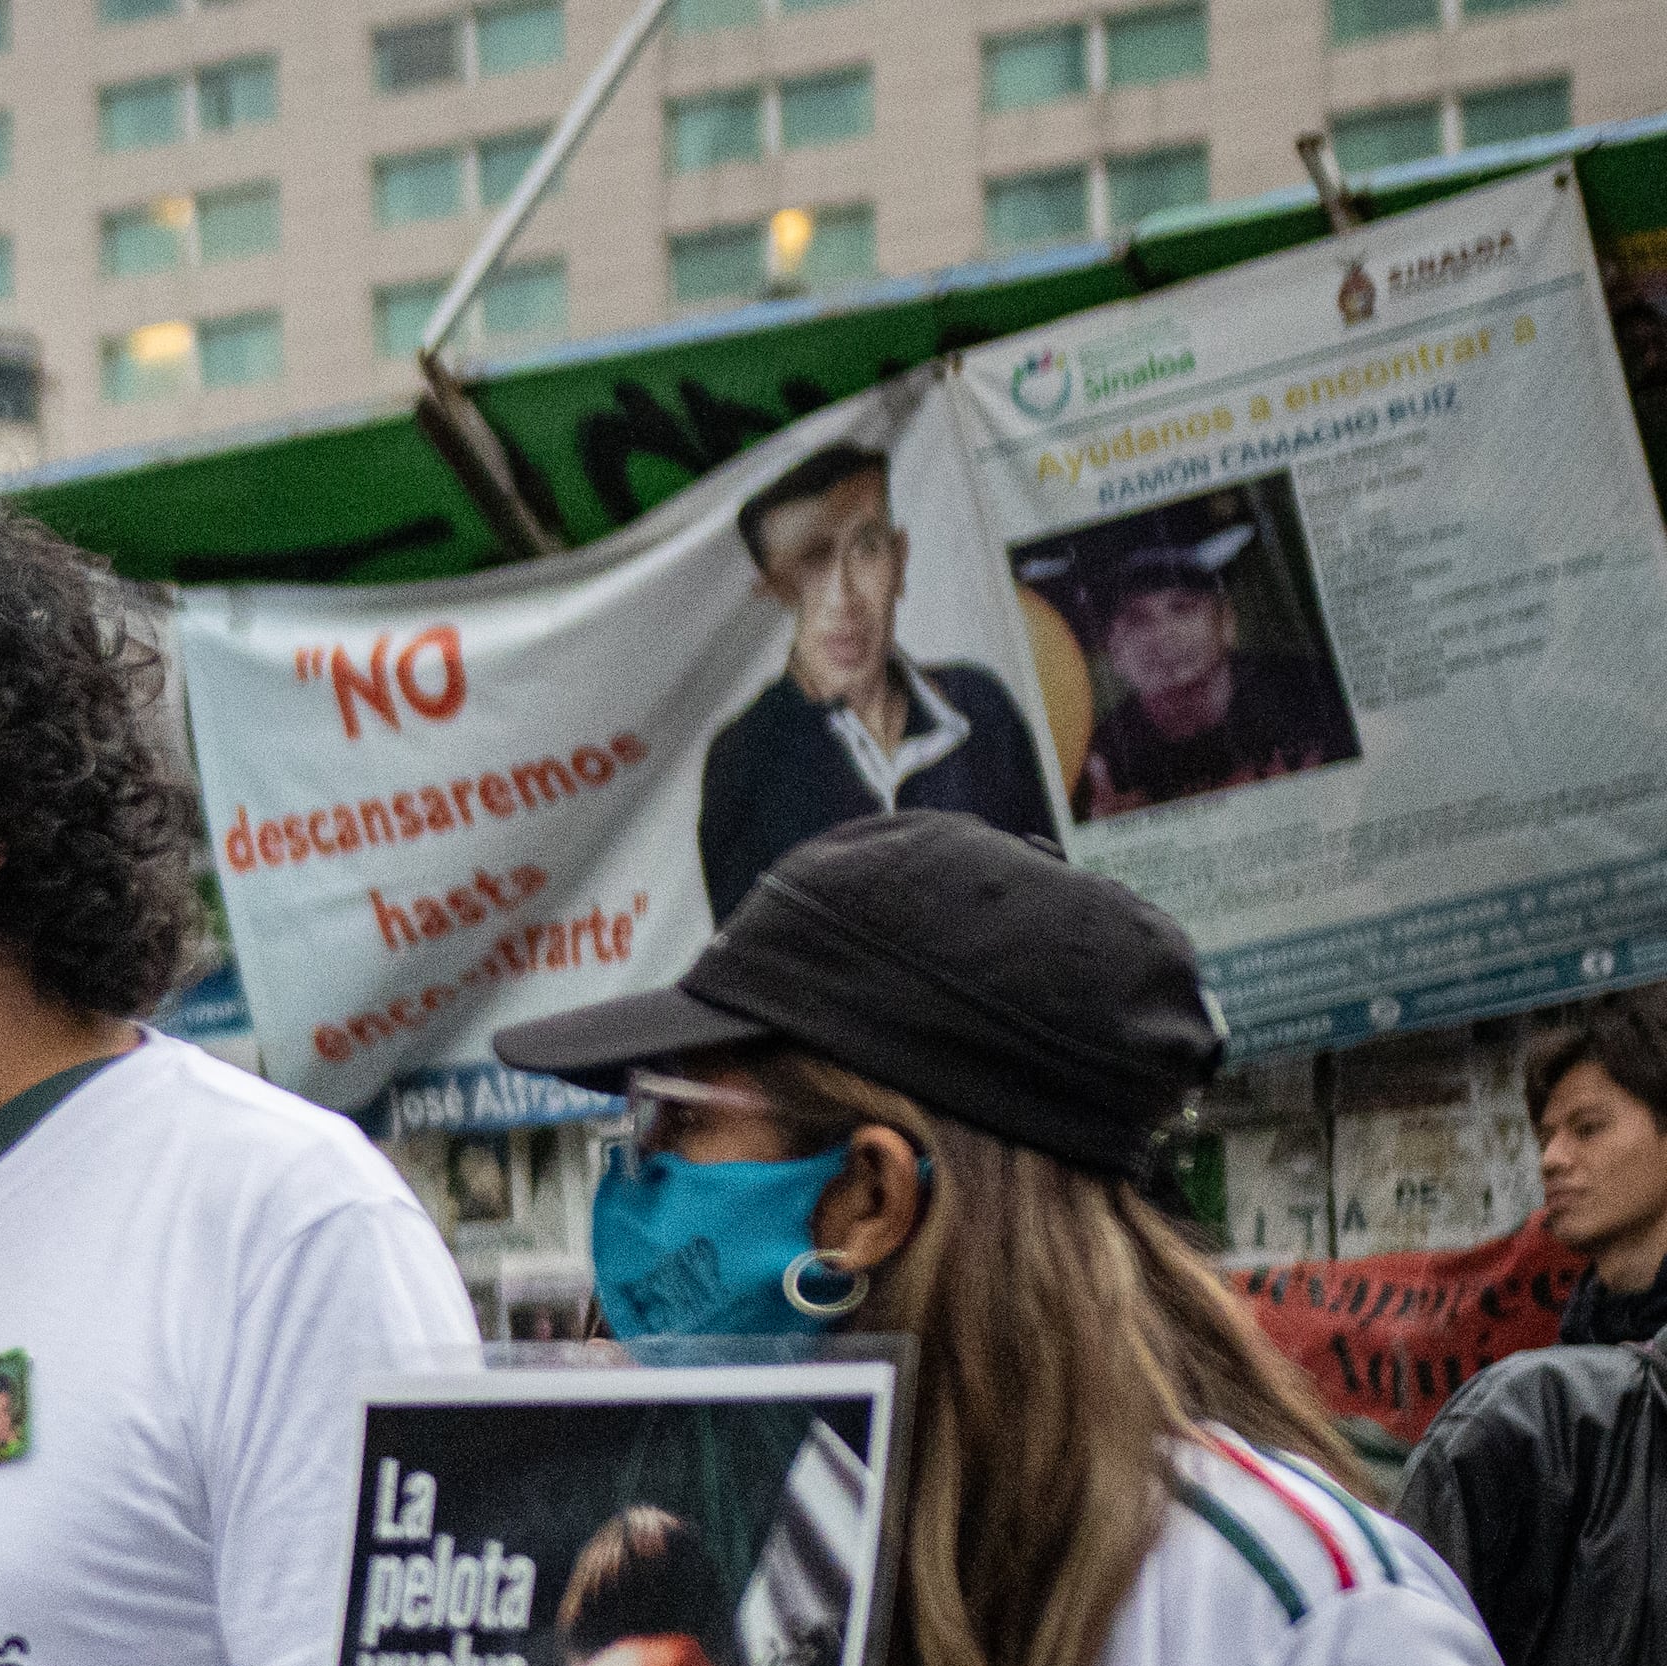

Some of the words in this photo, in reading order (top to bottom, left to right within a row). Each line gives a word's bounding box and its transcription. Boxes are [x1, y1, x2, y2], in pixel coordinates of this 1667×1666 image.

[1284, 325, 1492, 417] encontrar
[296, 622, 467, 742] "NO
[225, 733, 648, 874] descansaremos
[368, 865, 547, 951] hasta
[377, 1457, 437, 1541] La
[362, 1534, 536, 1645] pelota
